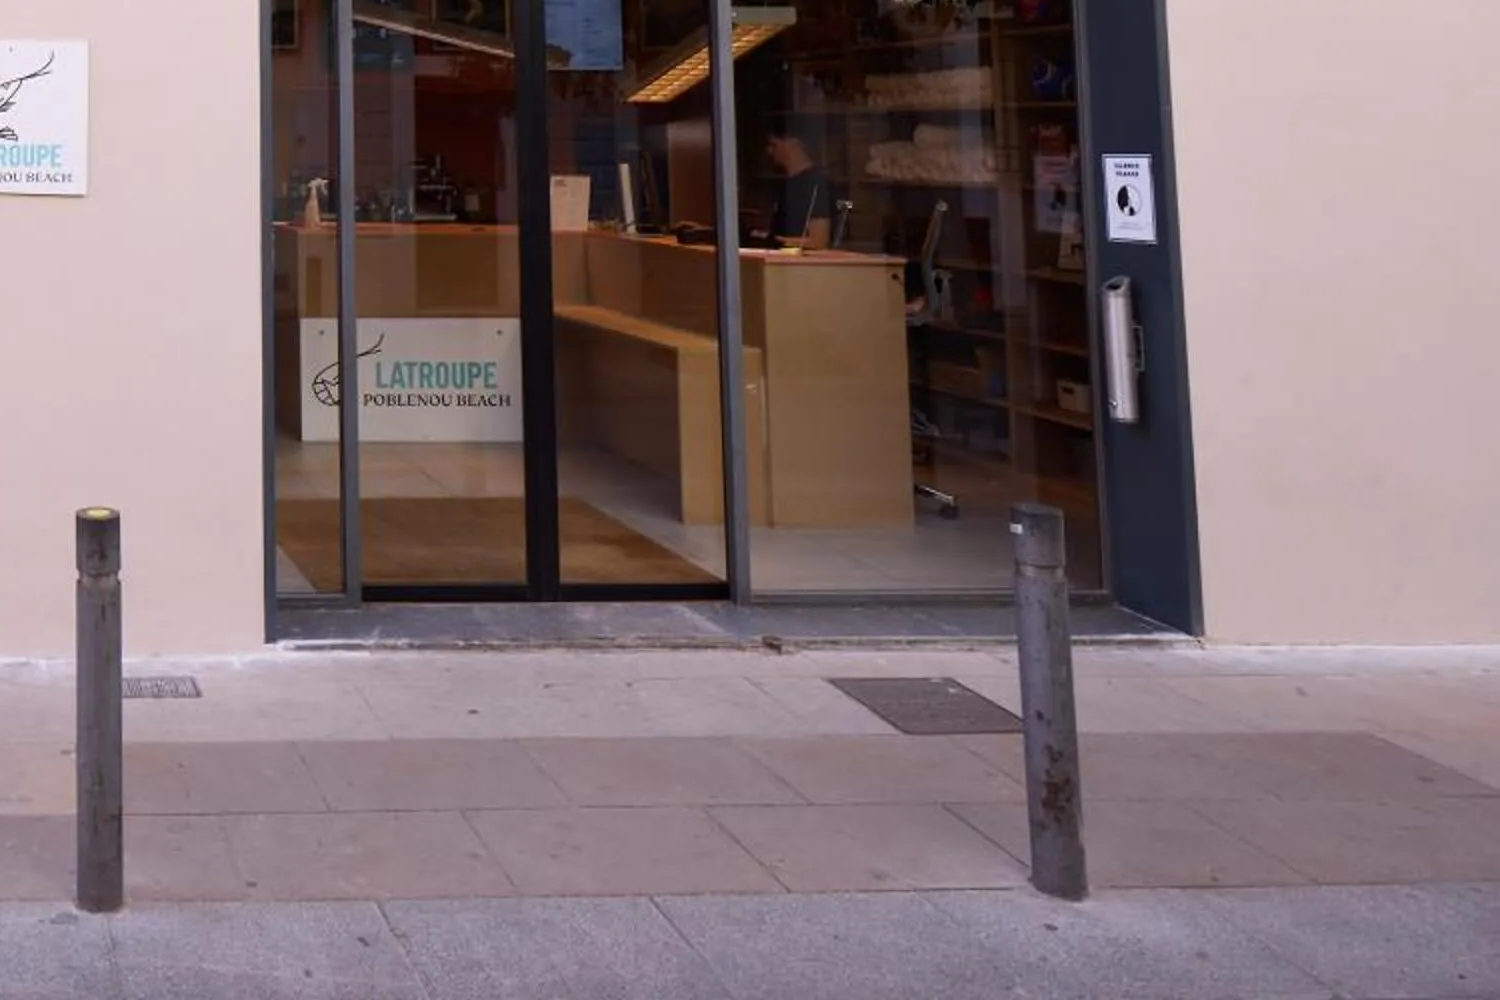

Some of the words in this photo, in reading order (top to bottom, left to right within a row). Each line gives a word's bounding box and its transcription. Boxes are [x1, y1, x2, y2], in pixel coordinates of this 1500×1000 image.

[25, 172, 73, 183] BEACH
[375, 361, 498, 389] LATROUPE
[363, 393, 452, 407] POBLENOU
[456, 394, 511, 407] BEACH
